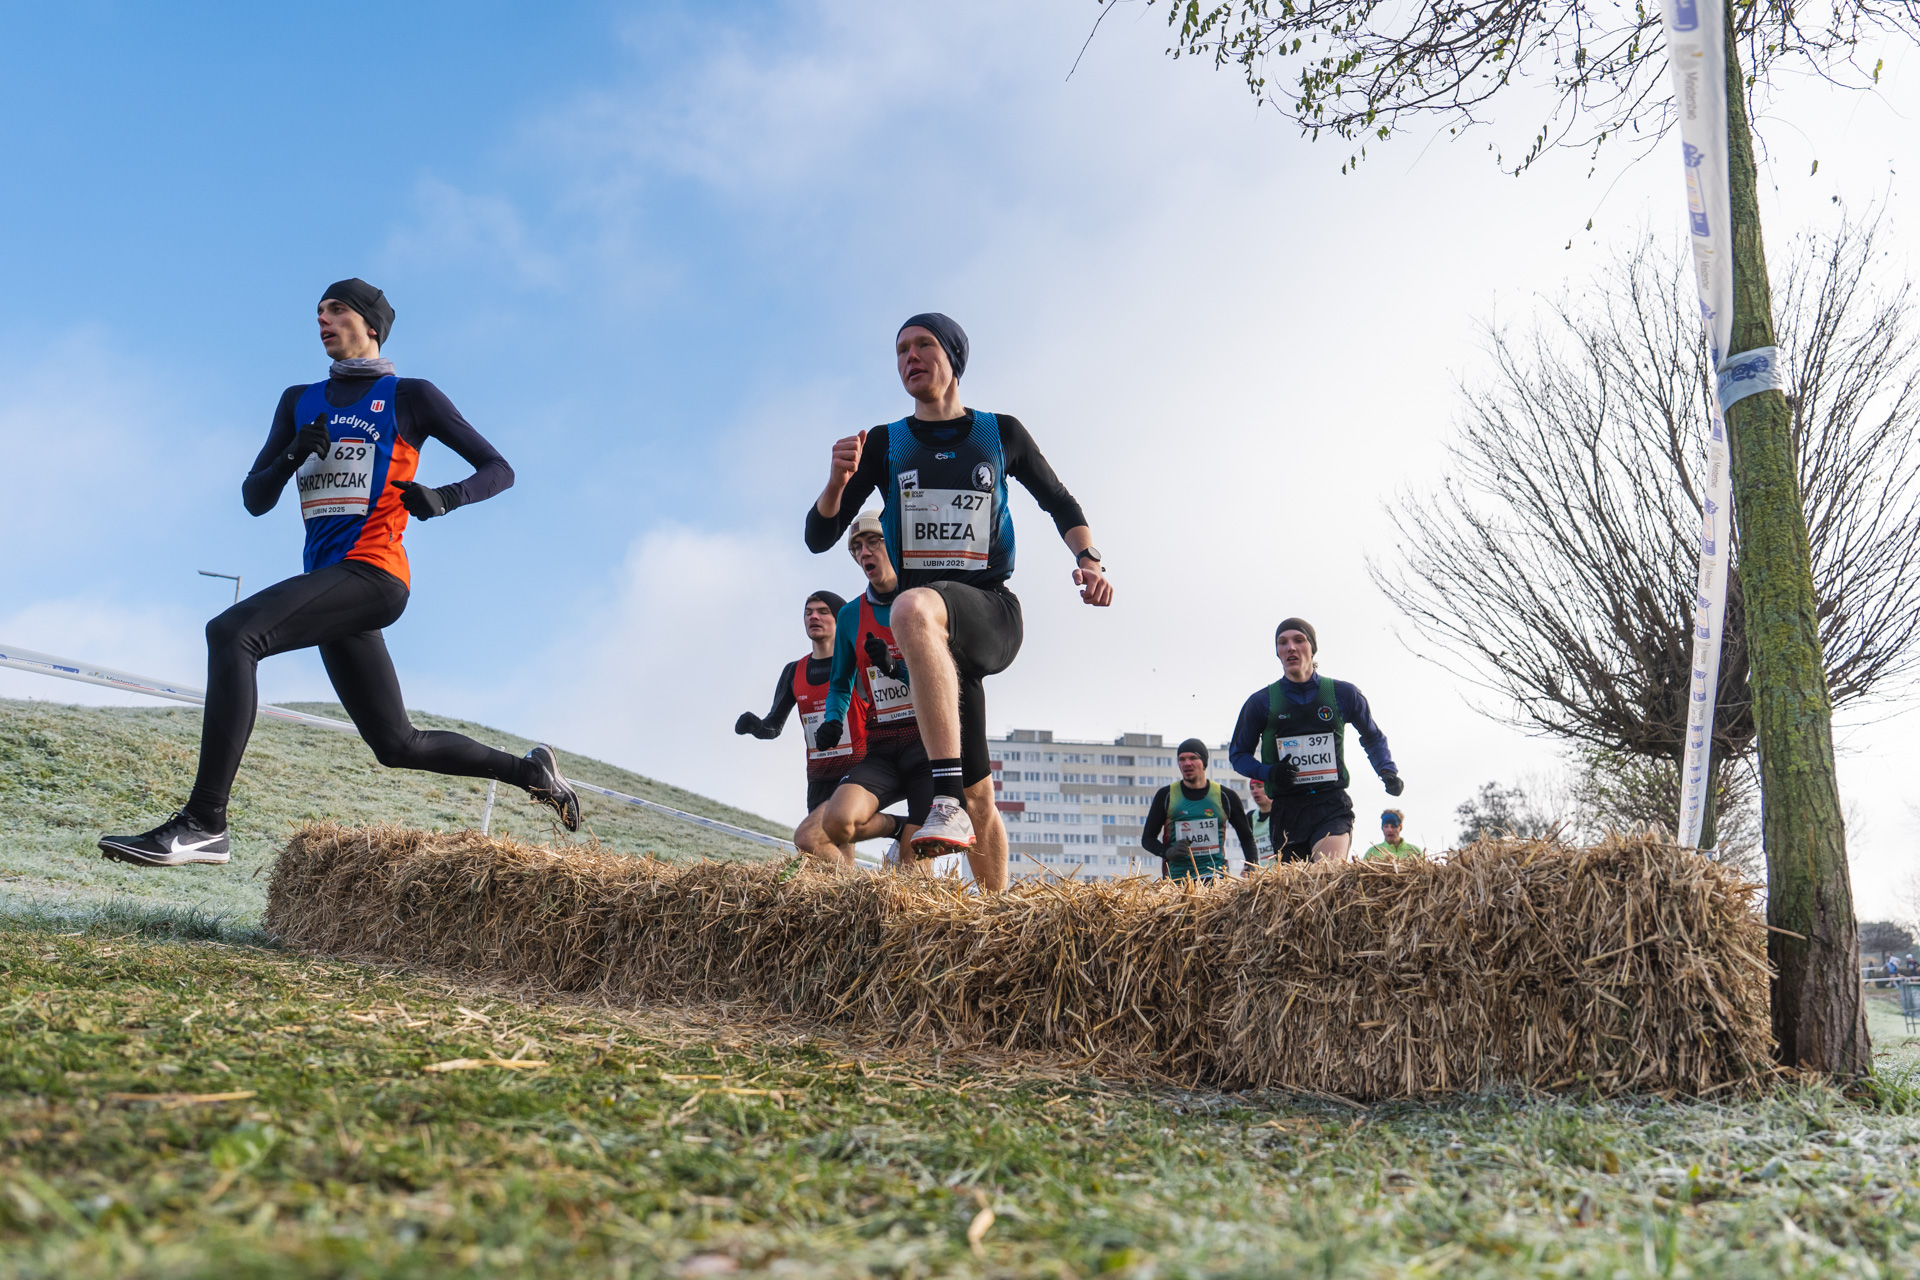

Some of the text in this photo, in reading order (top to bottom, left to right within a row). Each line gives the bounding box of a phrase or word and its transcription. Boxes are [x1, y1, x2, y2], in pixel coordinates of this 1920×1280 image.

[1684, 71, 1700, 120] Ministerstwo
[330, 413, 381, 441] Jedynka
[334, 446, 367, 461] 629
[300, 472, 368, 492] SKRZYPCZAK
[1709, 461, 1721, 489] Ministerstwo
[951, 494, 984, 511] 427
[312, 506, 346, 516] LUBIN 2025
[915, 522, 976, 541] BREZA
[873, 685, 911, 702] SZYDŁO
[890, 709, 916, 719] LUBIN 20
[1282, 739, 1299, 747] RCS
[1308, 735, 1329, 747] 397
[1291, 752, 1332, 767] OSICKI
[1199, 820, 1215, 829] 115
